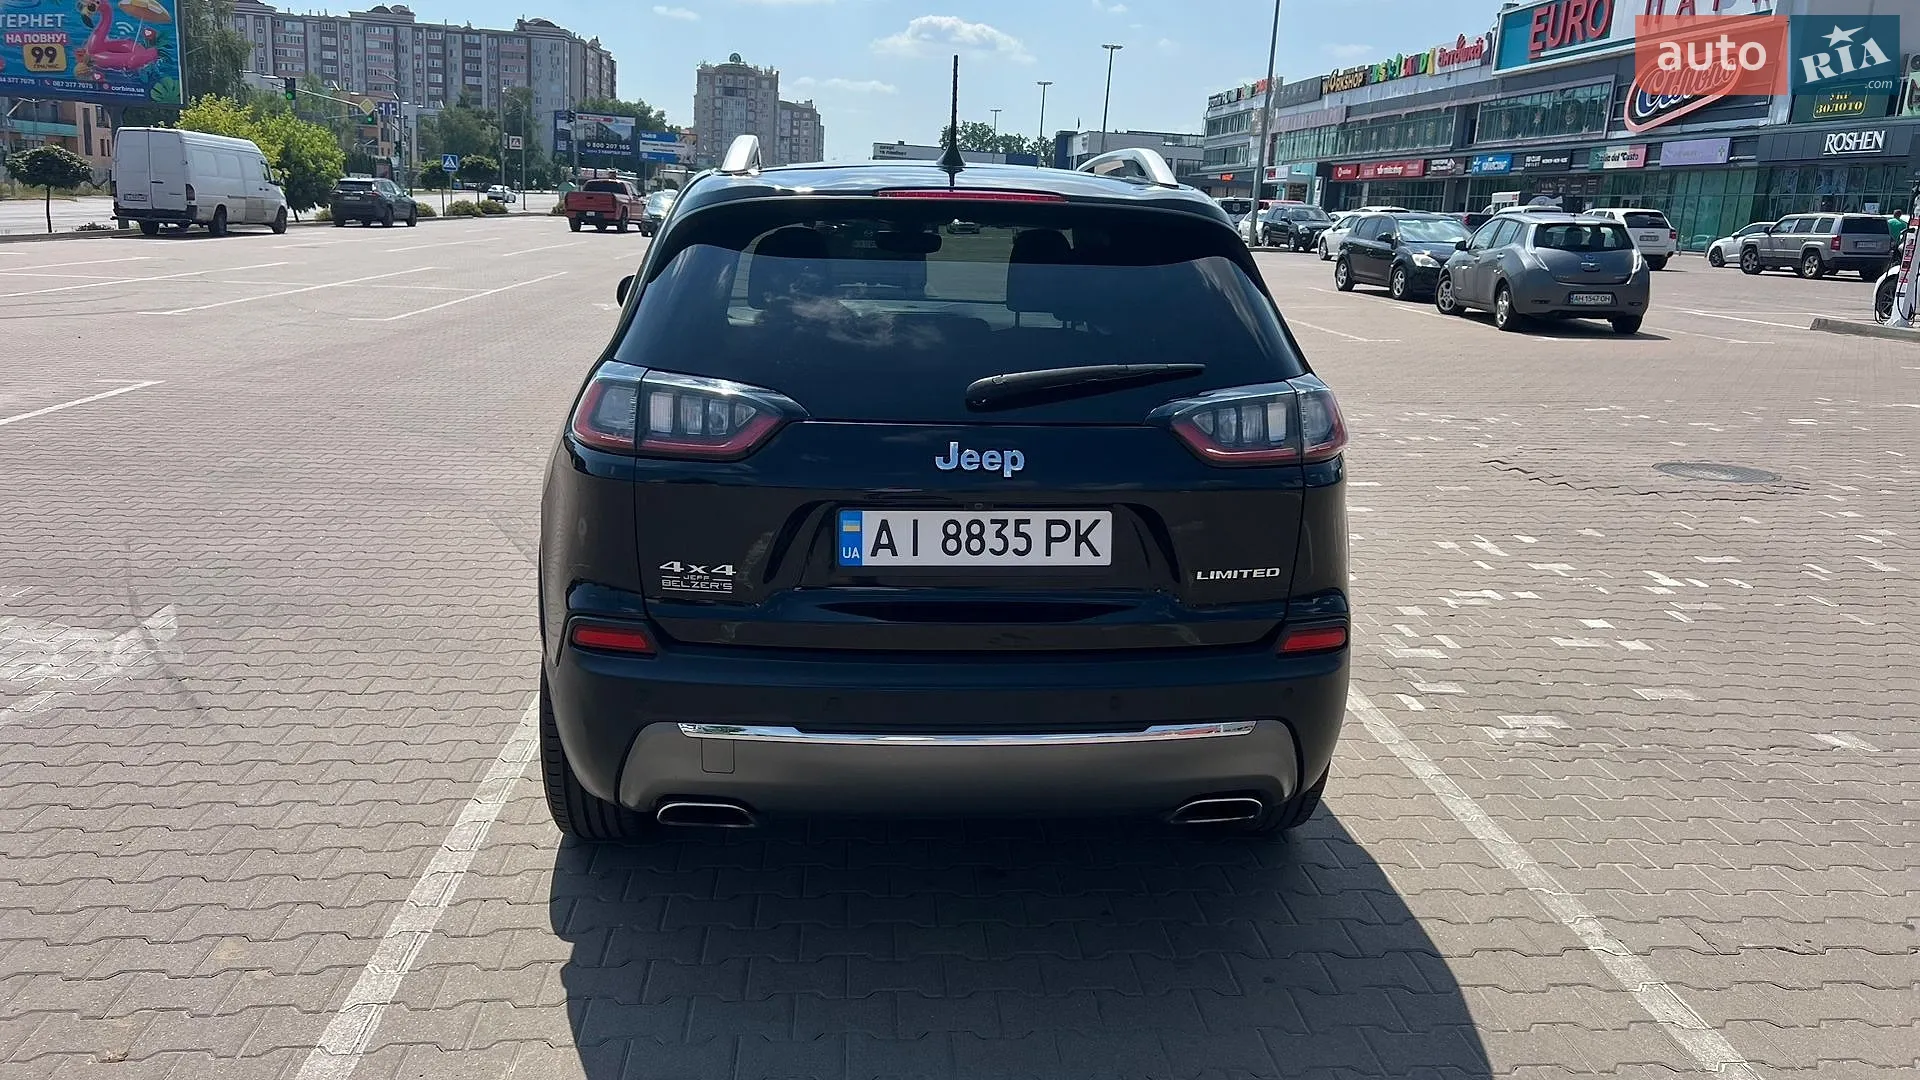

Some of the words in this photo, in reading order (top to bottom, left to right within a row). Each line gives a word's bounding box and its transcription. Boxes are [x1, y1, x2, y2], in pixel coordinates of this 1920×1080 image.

[1528, 0, 1613, 51] EURO
[6, 33, 22, 43] НА
[23, 33, 67, 44] ПОВНУ!
[31, 46, 57, 64] 99
[1322, 70, 1364, 94] WORKSHOP
[1815, 101, 1863, 114] ЗОЛОТО
[1823, 130, 1886, 154] ROSHEN
[935, 441, 1025, 478] Jeep
[870, 519, 919, 557] AI
[941, 519, 1033, 557] 8835
[1045, 519, 1102, 557] PK
[842, 546, 861, 560] UA
[1196, 567, 1281, 580] LIMITED
[661, 579, 733, 590] BELZER'S
